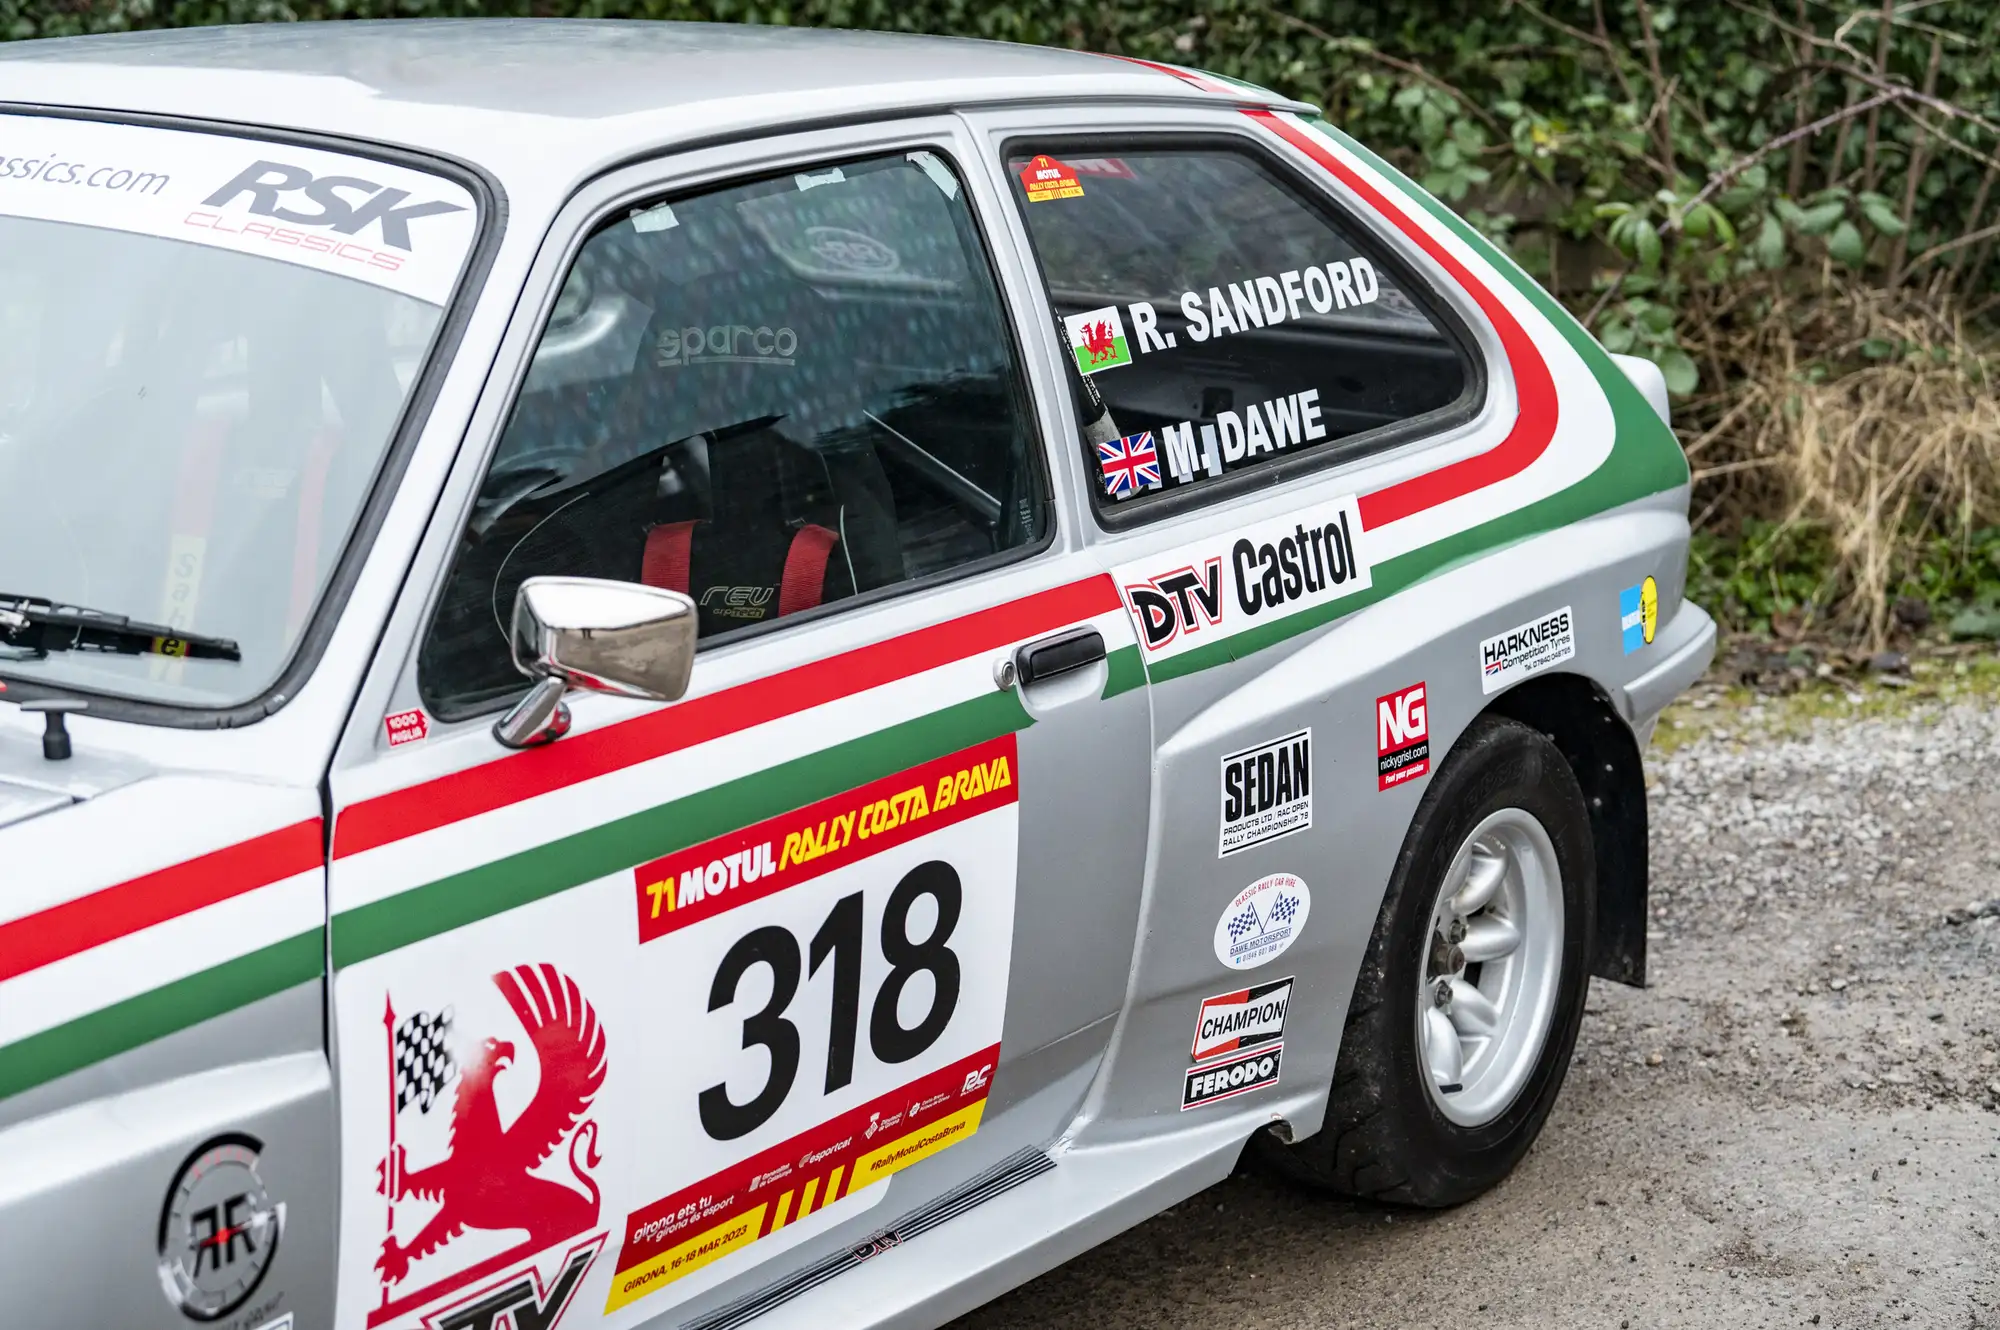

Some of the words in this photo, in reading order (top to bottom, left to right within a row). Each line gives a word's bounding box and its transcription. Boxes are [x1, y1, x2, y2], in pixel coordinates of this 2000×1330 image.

[1036, 168, 1061, 180] MOTUL
[200, 160, 470, 252] RSK
[184, 212, 406, 271] CLASSICS
[1128, 302, 1177, 354] R.
[1180, 257, 1379, 342] SANDFORD
[656, 325, 798, 365] sparco
[1161, 420, 1211, 478] M.
[1216, 388, 1327, 463] DAWE
[1127, 558, 1221, 649] DTV
[1232, 510, 1357, 616] Castrol
[1484, 613, 1569, 665] HARKNESS
[1502, 643, 1549, 670] Competition
[1550, 635, 1570, 651] Tyres
[389, 712, 418, 730] 1000
[1379, 687, 1426, 750] NG
[1225, 739, 1309, 822] SEDAN
[1380, 745, 1427, 771] nickygrist.com
[646, 876, 676, 919] 71
[677, 841, 777, 909] MOTUL
[778, 810, 856, 871] RALLY
[857, 785, 929, 840] COSTA
[932, 756, 1012, 812] BRAVA
[1223, 833, 1245, 848] RALLY
[1247, 815, 1299, 840] CHAMPIONSHIP
[1224, 817, 1259, 836] PRODUCTS
[1261, 813, 1273, 824] LTD
[1277, 807, 1291, 819] RAC
[1292, 800, 1309, 813] OPEN
[1235, 886, 1257, 907] CLASSIC
[1258, 880, 1273, 892] RALLY
[1274, 877, 1285, 887] CAR
[1285, 877, 1297, 887] HIRE
[1230, 942, 1249, 955] DAWE
[1249, 927, 1292, 949] MOTORSPORT
[699, 860, 962, 1141] 318
[1201, 999, 1286, 1040] CHAMPION
[1190, 1056, 1274, 1098] FERODO
[809, 1136, 852, 1164] esportcat
[870, 1120, 966, 1171] #RallyMotulCostaBrava
[633, 1212, 675, 1244] girona
[677, 1202, 697, 1220] ets
[699, 1194, 713, 1210] tu
[655, 1218, 689, 1243] girona
[702, 1195, 735, 1217] esport
[623, 1265, 668, 1293] GIRONA,
[671, 1249, 697, 1271] 16-18
[697, 1238, 721, 1257] MAR
[720, 1224, 748, 1245] 2023
